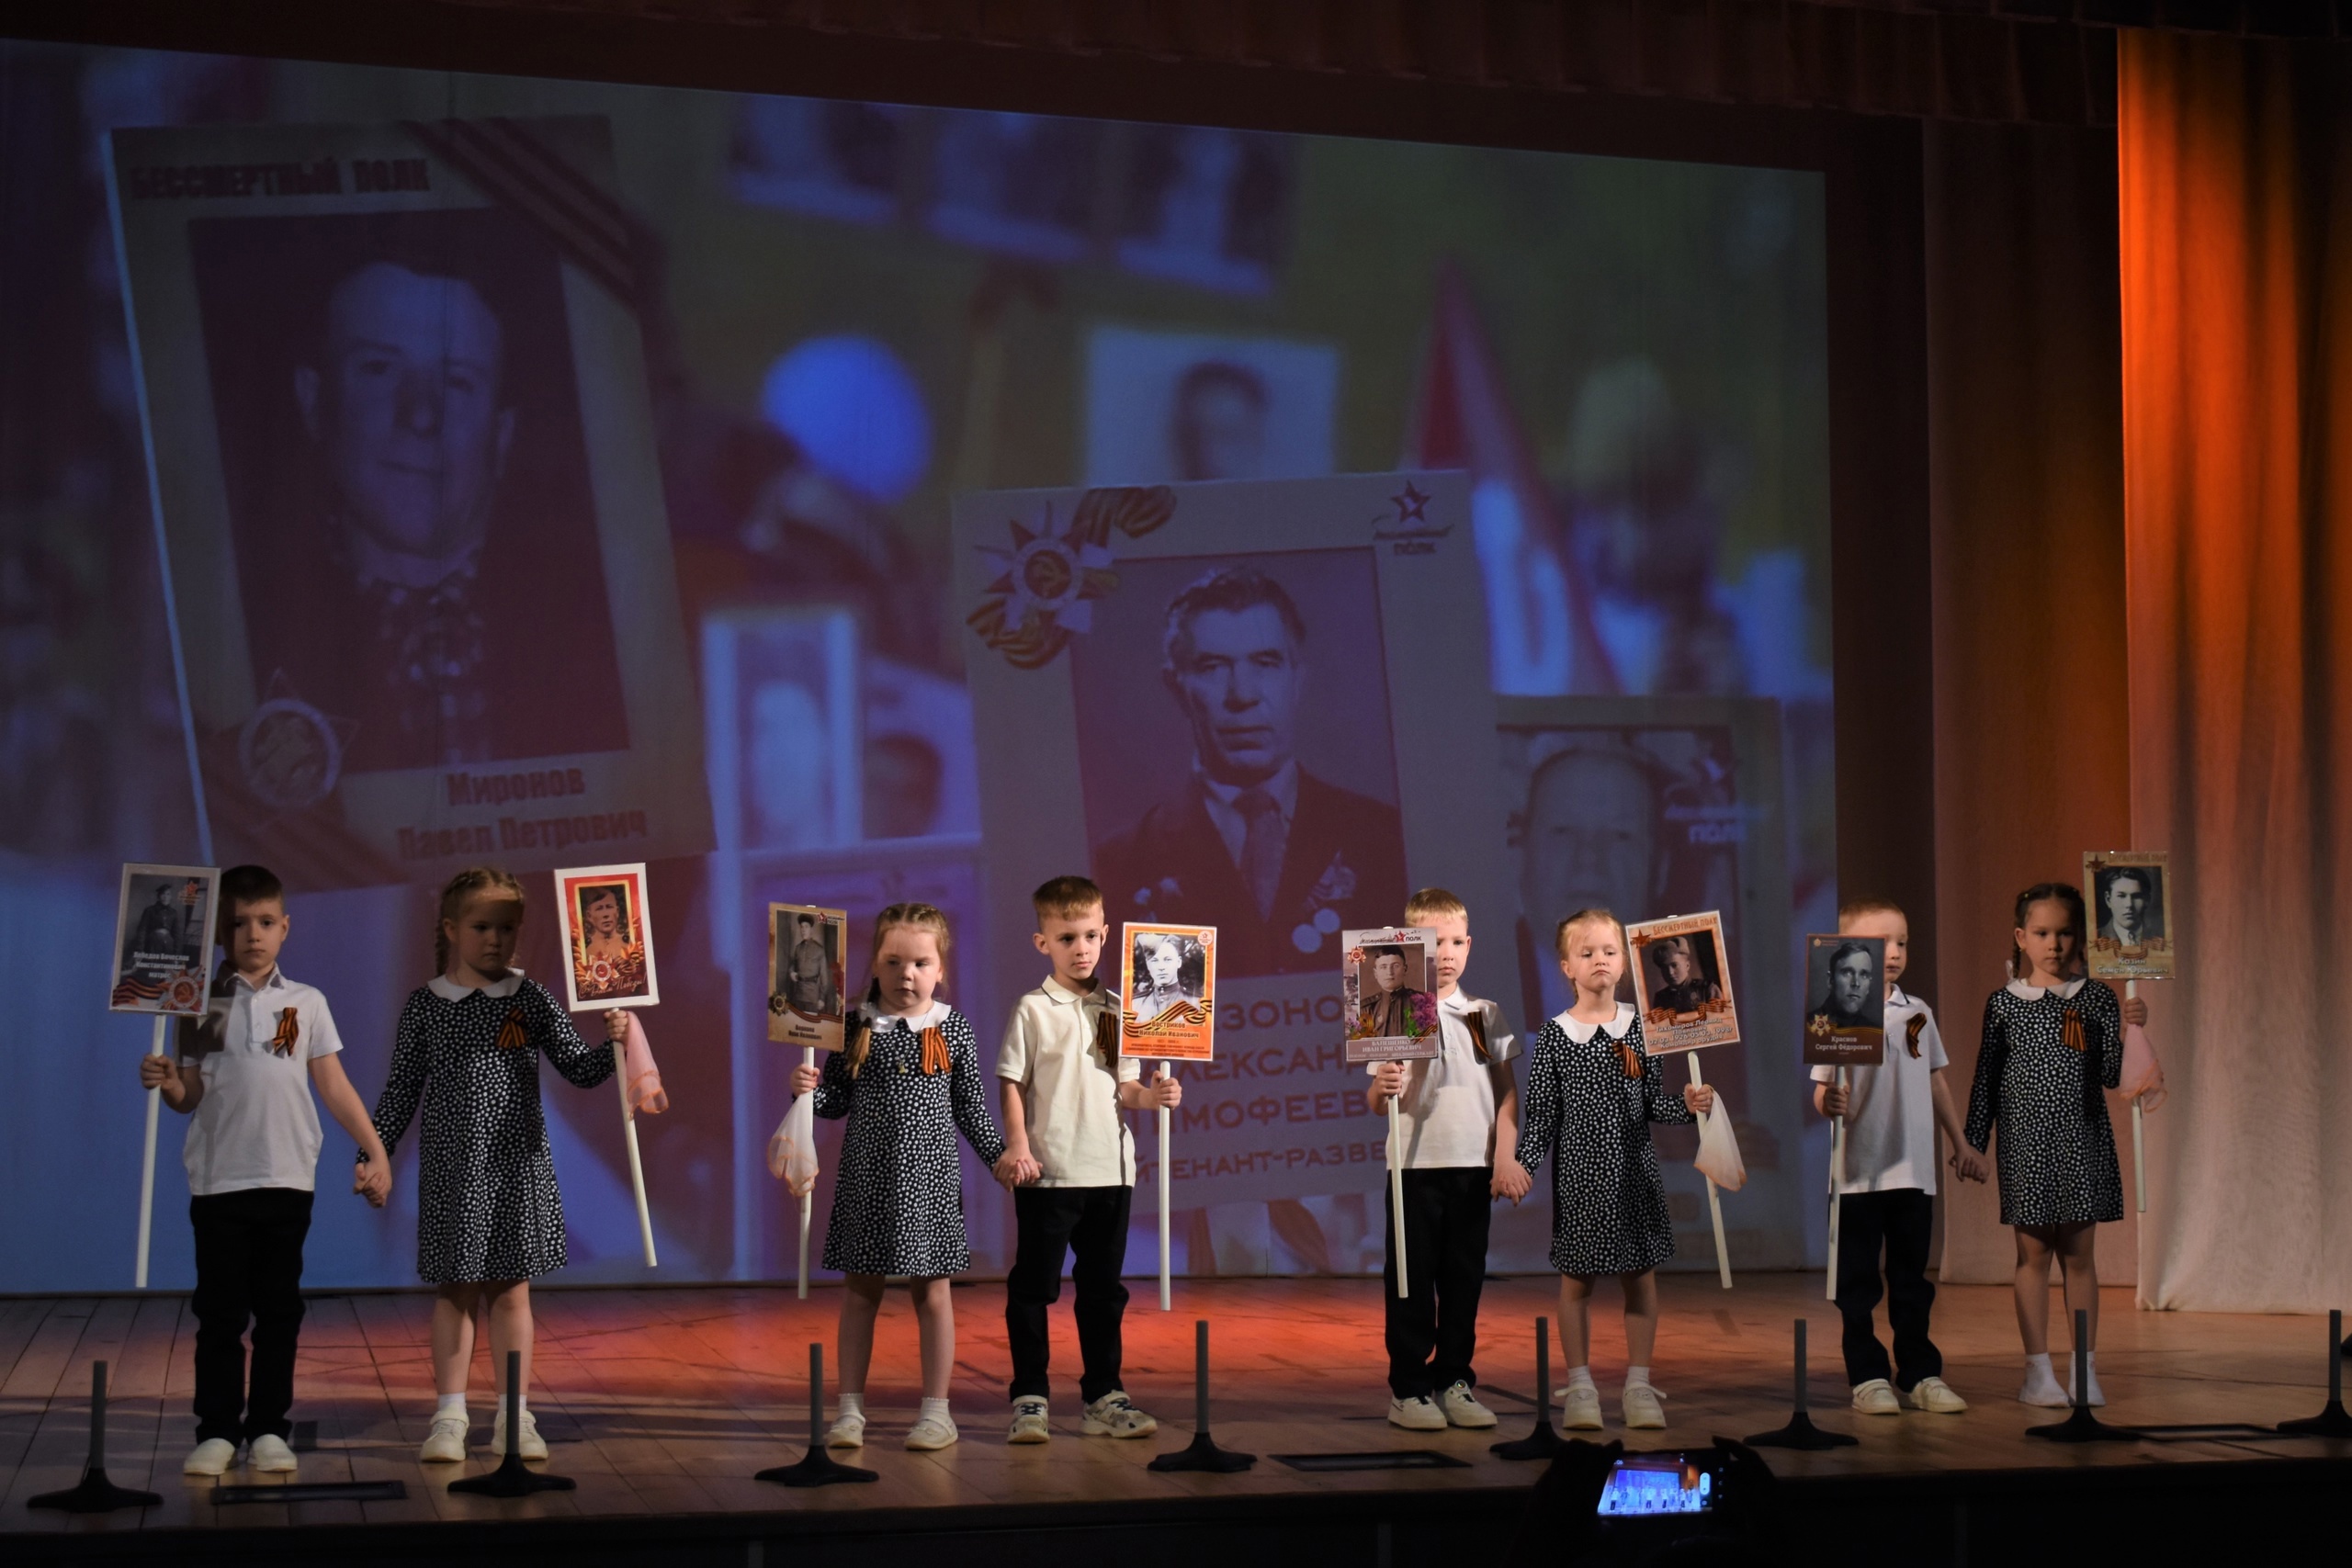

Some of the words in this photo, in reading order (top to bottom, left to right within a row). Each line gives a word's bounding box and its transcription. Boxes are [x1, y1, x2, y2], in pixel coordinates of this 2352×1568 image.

[130, 155, 343, 199] БЕССМЕРТНЫЙ
[353, 159, 430, 193] ПОЛК
[447, 769, 585, 807] Миронов
[398, 825, 495, 860] Павел
[499, 809, 648, 850] Петрович
[1151, 1021, 1186, 1029] Востриков
[1215, 995, 1344, 1032] ЗОНО
[1138, 1029, 1168, 1037] Николай
[1815, 1043, 1838, 1052] Сергей
